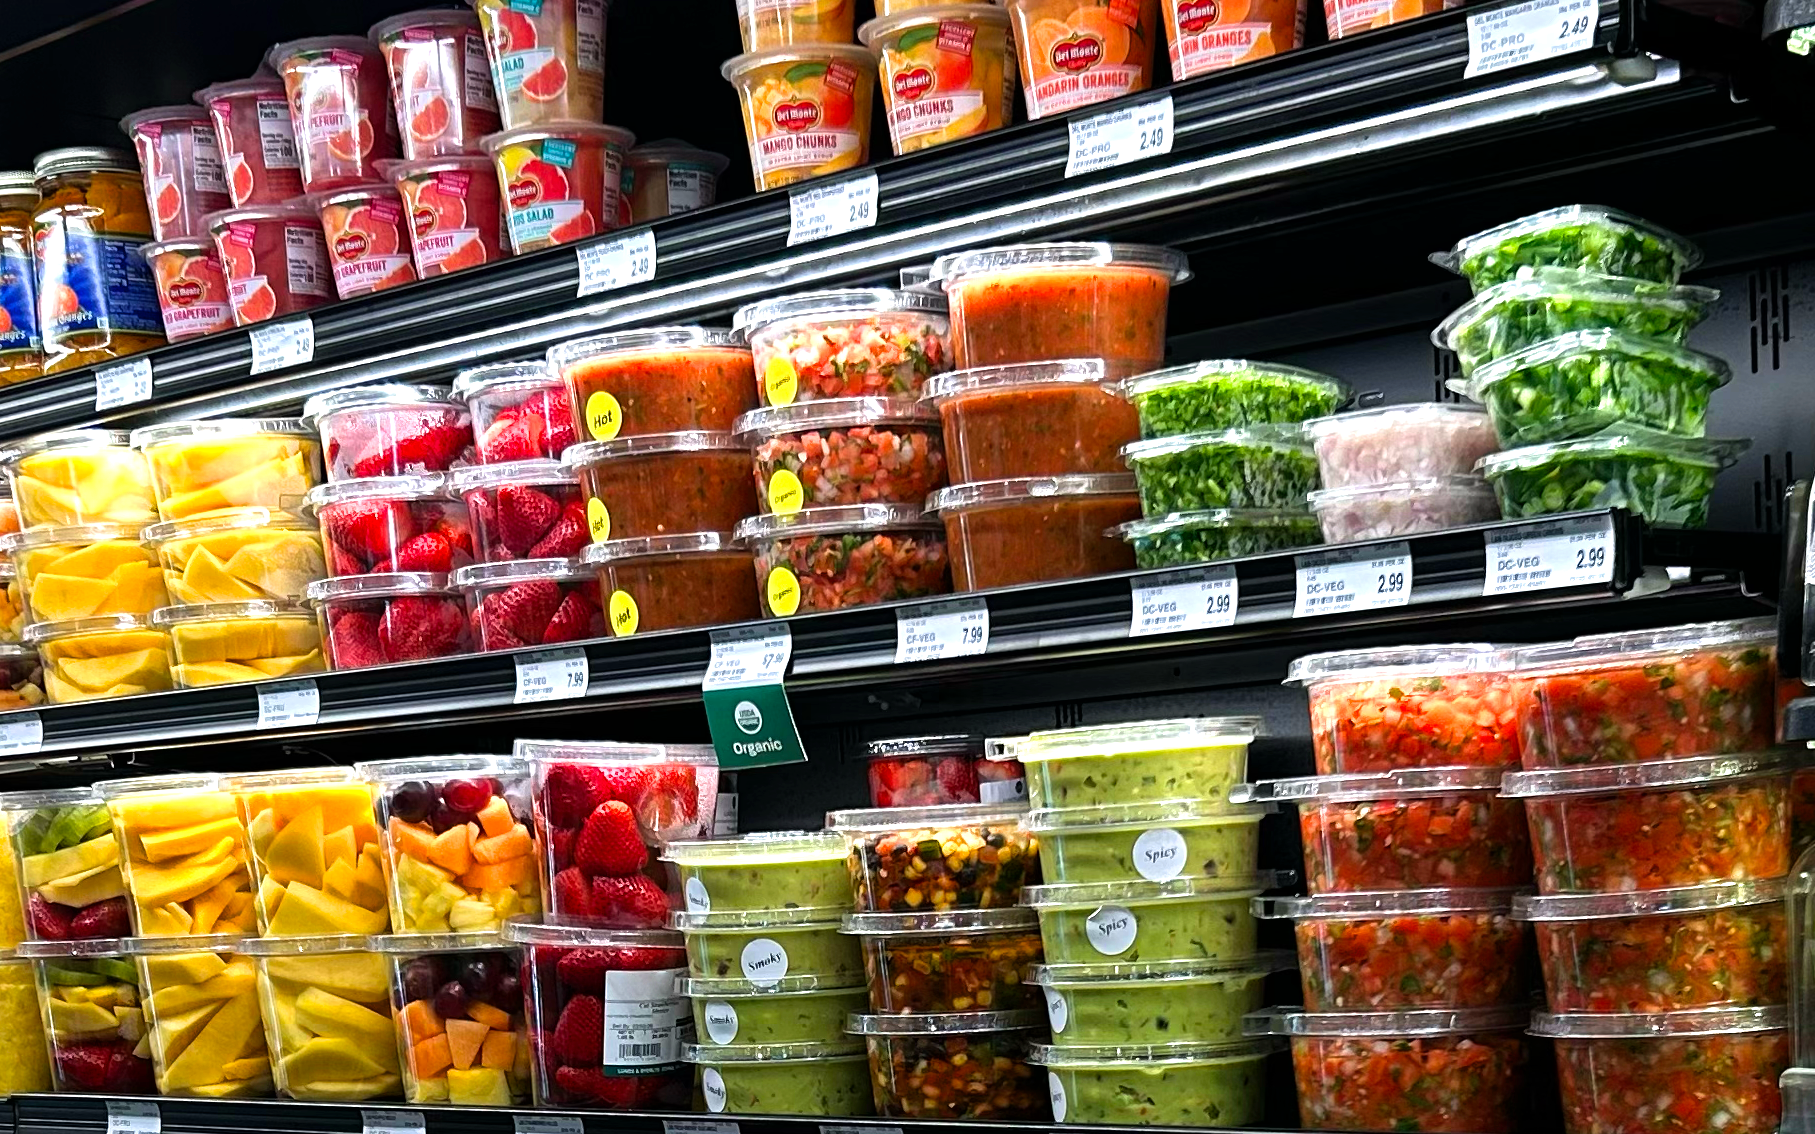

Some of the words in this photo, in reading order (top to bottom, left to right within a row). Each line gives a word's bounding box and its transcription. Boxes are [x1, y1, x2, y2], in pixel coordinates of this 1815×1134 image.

[1190, 4, 1216, 20] Monte
[1559, 15, 1589, 39] 2.49
[1201, 29, 1251, 51] ORANGES
[1481, 33, 1525, 53] DC-PRO
[1055, 49, 1069, 63] Del
[1070, 44, 1099, 59] Monte
[907, 76, 931, 88] Monte
[1082, 71, 1130, 89] ORANGES
[776, 109, 790, 122] Del
[791, 108, 817, 119] Monte
[913, 99, 954, 117] CHUNKS
[310, 114, 344, 128] PEFRUIT
[763, 137, 793, 155] MANGO
[796, 135, 837, 150] CHUNKS
[1140, 127, 1163, 151] 2.49
[527, 208, 554, 225] SALAD
[850, 201, 869, 222] 2.49
[417, 235, 454, 251] APEFRUIT
[341, 260, 387, 279] GRAPEFRUIT
[631, 258, 648, 277] 2.49
[174, 307, 220, 321] GRAPEFRUIT
[594, 410, 613, 429] Hot
[592, 516, 605, 532] Hot
[1497, 556, 1540, 571] DC-VEG
[1576, 547, 1605, 569] 2.99
[1307, 580, 1345, 595] DC-VEG
[1378, 572, 1403, 594] 2.99
[1142, 600, 1177, 615] DC-VEG
[1206, 594, 1230, 615] 2.99
[615, 608, 631, 628] Hot
[906, 632, 936, 644] CF-VEG
[962, 625, 983, 644] 7.99
[567, 671, 583, 688] 7.99
[739, 709, 755, 717] USDA
[733, 737, 783, 757] Organic
[1144, 845, 1178, 863] Spicy
[1098, 917, 1128, 936] Spicy
[748, 952, 782, 972] Smoky
[706, 1082, 725, 1099] Smoky
